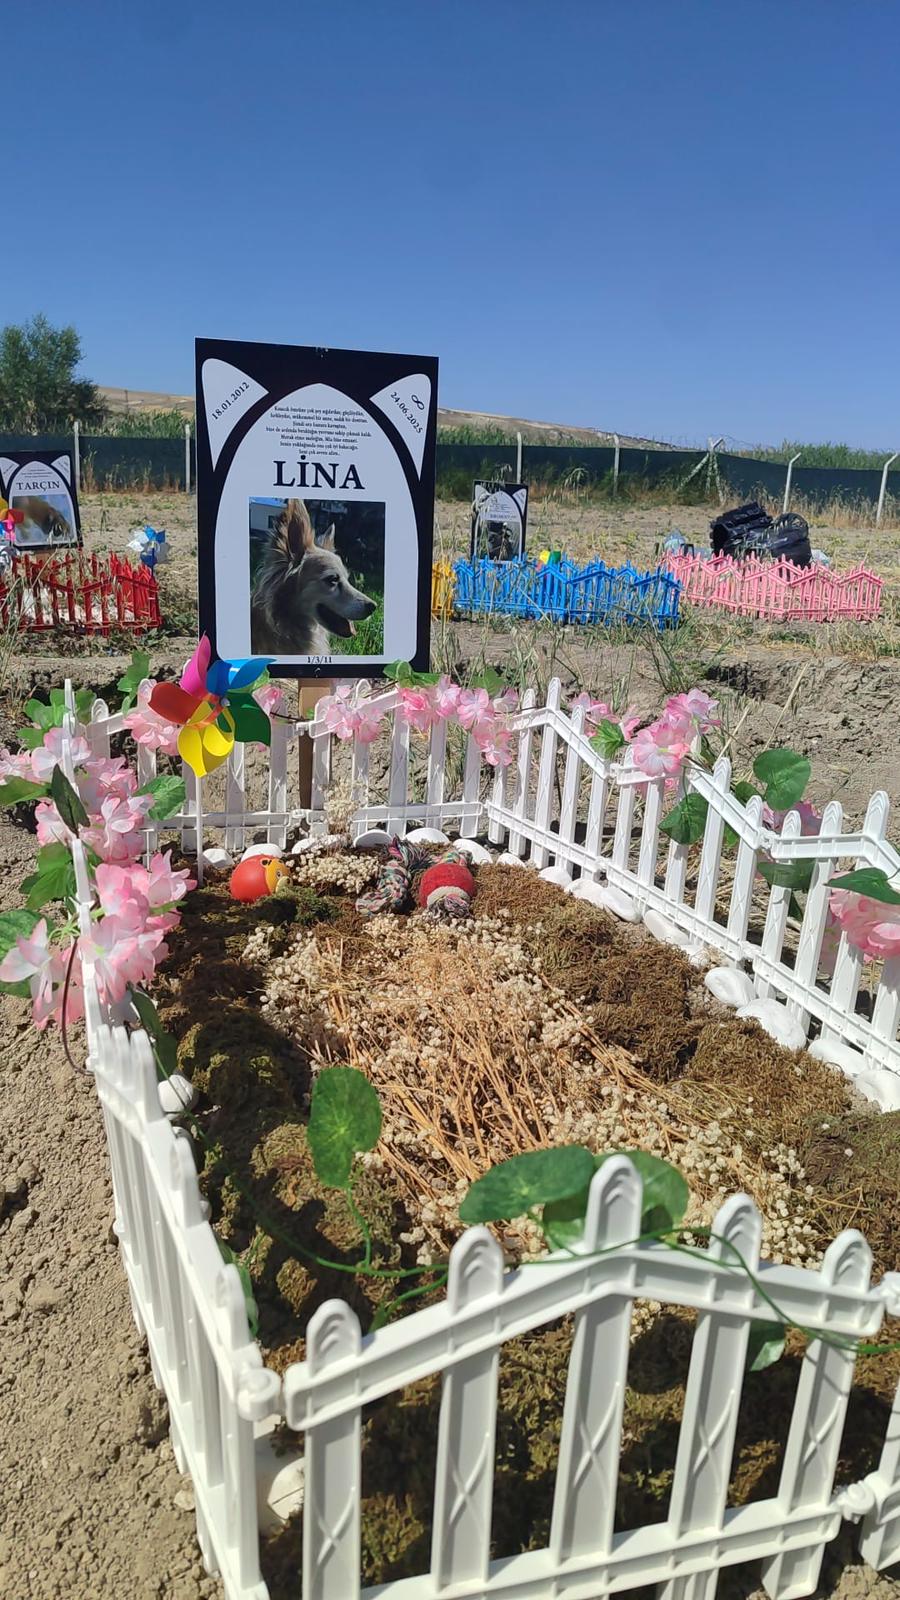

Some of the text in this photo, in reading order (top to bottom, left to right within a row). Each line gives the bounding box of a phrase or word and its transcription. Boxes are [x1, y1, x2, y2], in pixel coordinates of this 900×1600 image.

[212, 382, 250, 420] 18.01.2012
[391, 392, 423, 434] 24.06.2025
[16, 480, 60, 492] TARÇIN
[272, 455, 365, 490] LİNA
